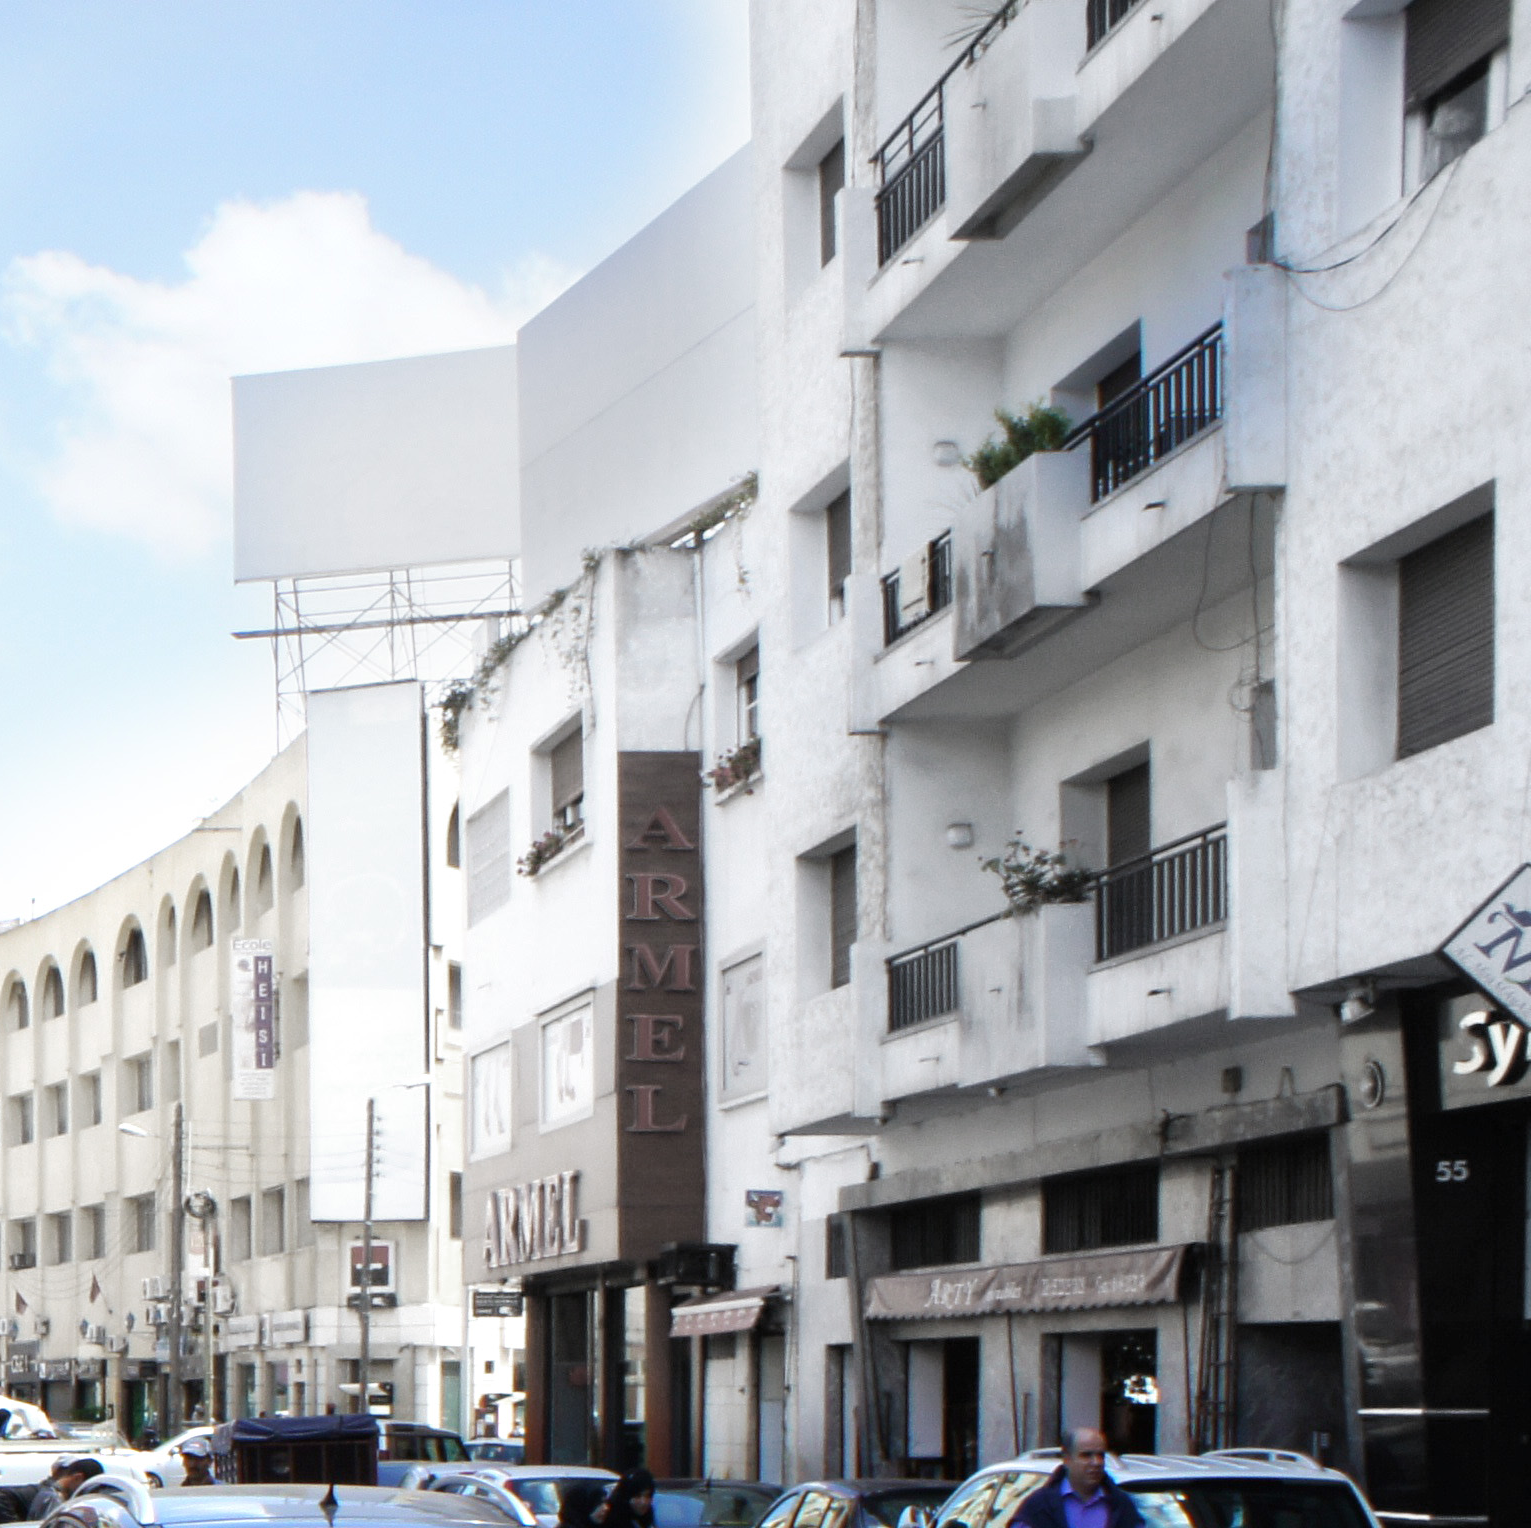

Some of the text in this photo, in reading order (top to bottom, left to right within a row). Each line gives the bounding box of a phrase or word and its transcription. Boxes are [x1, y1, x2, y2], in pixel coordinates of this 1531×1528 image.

[625, 806, 697, 1133] ARMEL
[1452, 1010, 1531, 1089] Sy
[1435, 1160, 1470, 1182] 55
[483, 1168, 588, 1268] ARMEL
[923, 1277, 978, 1309] ARTY
